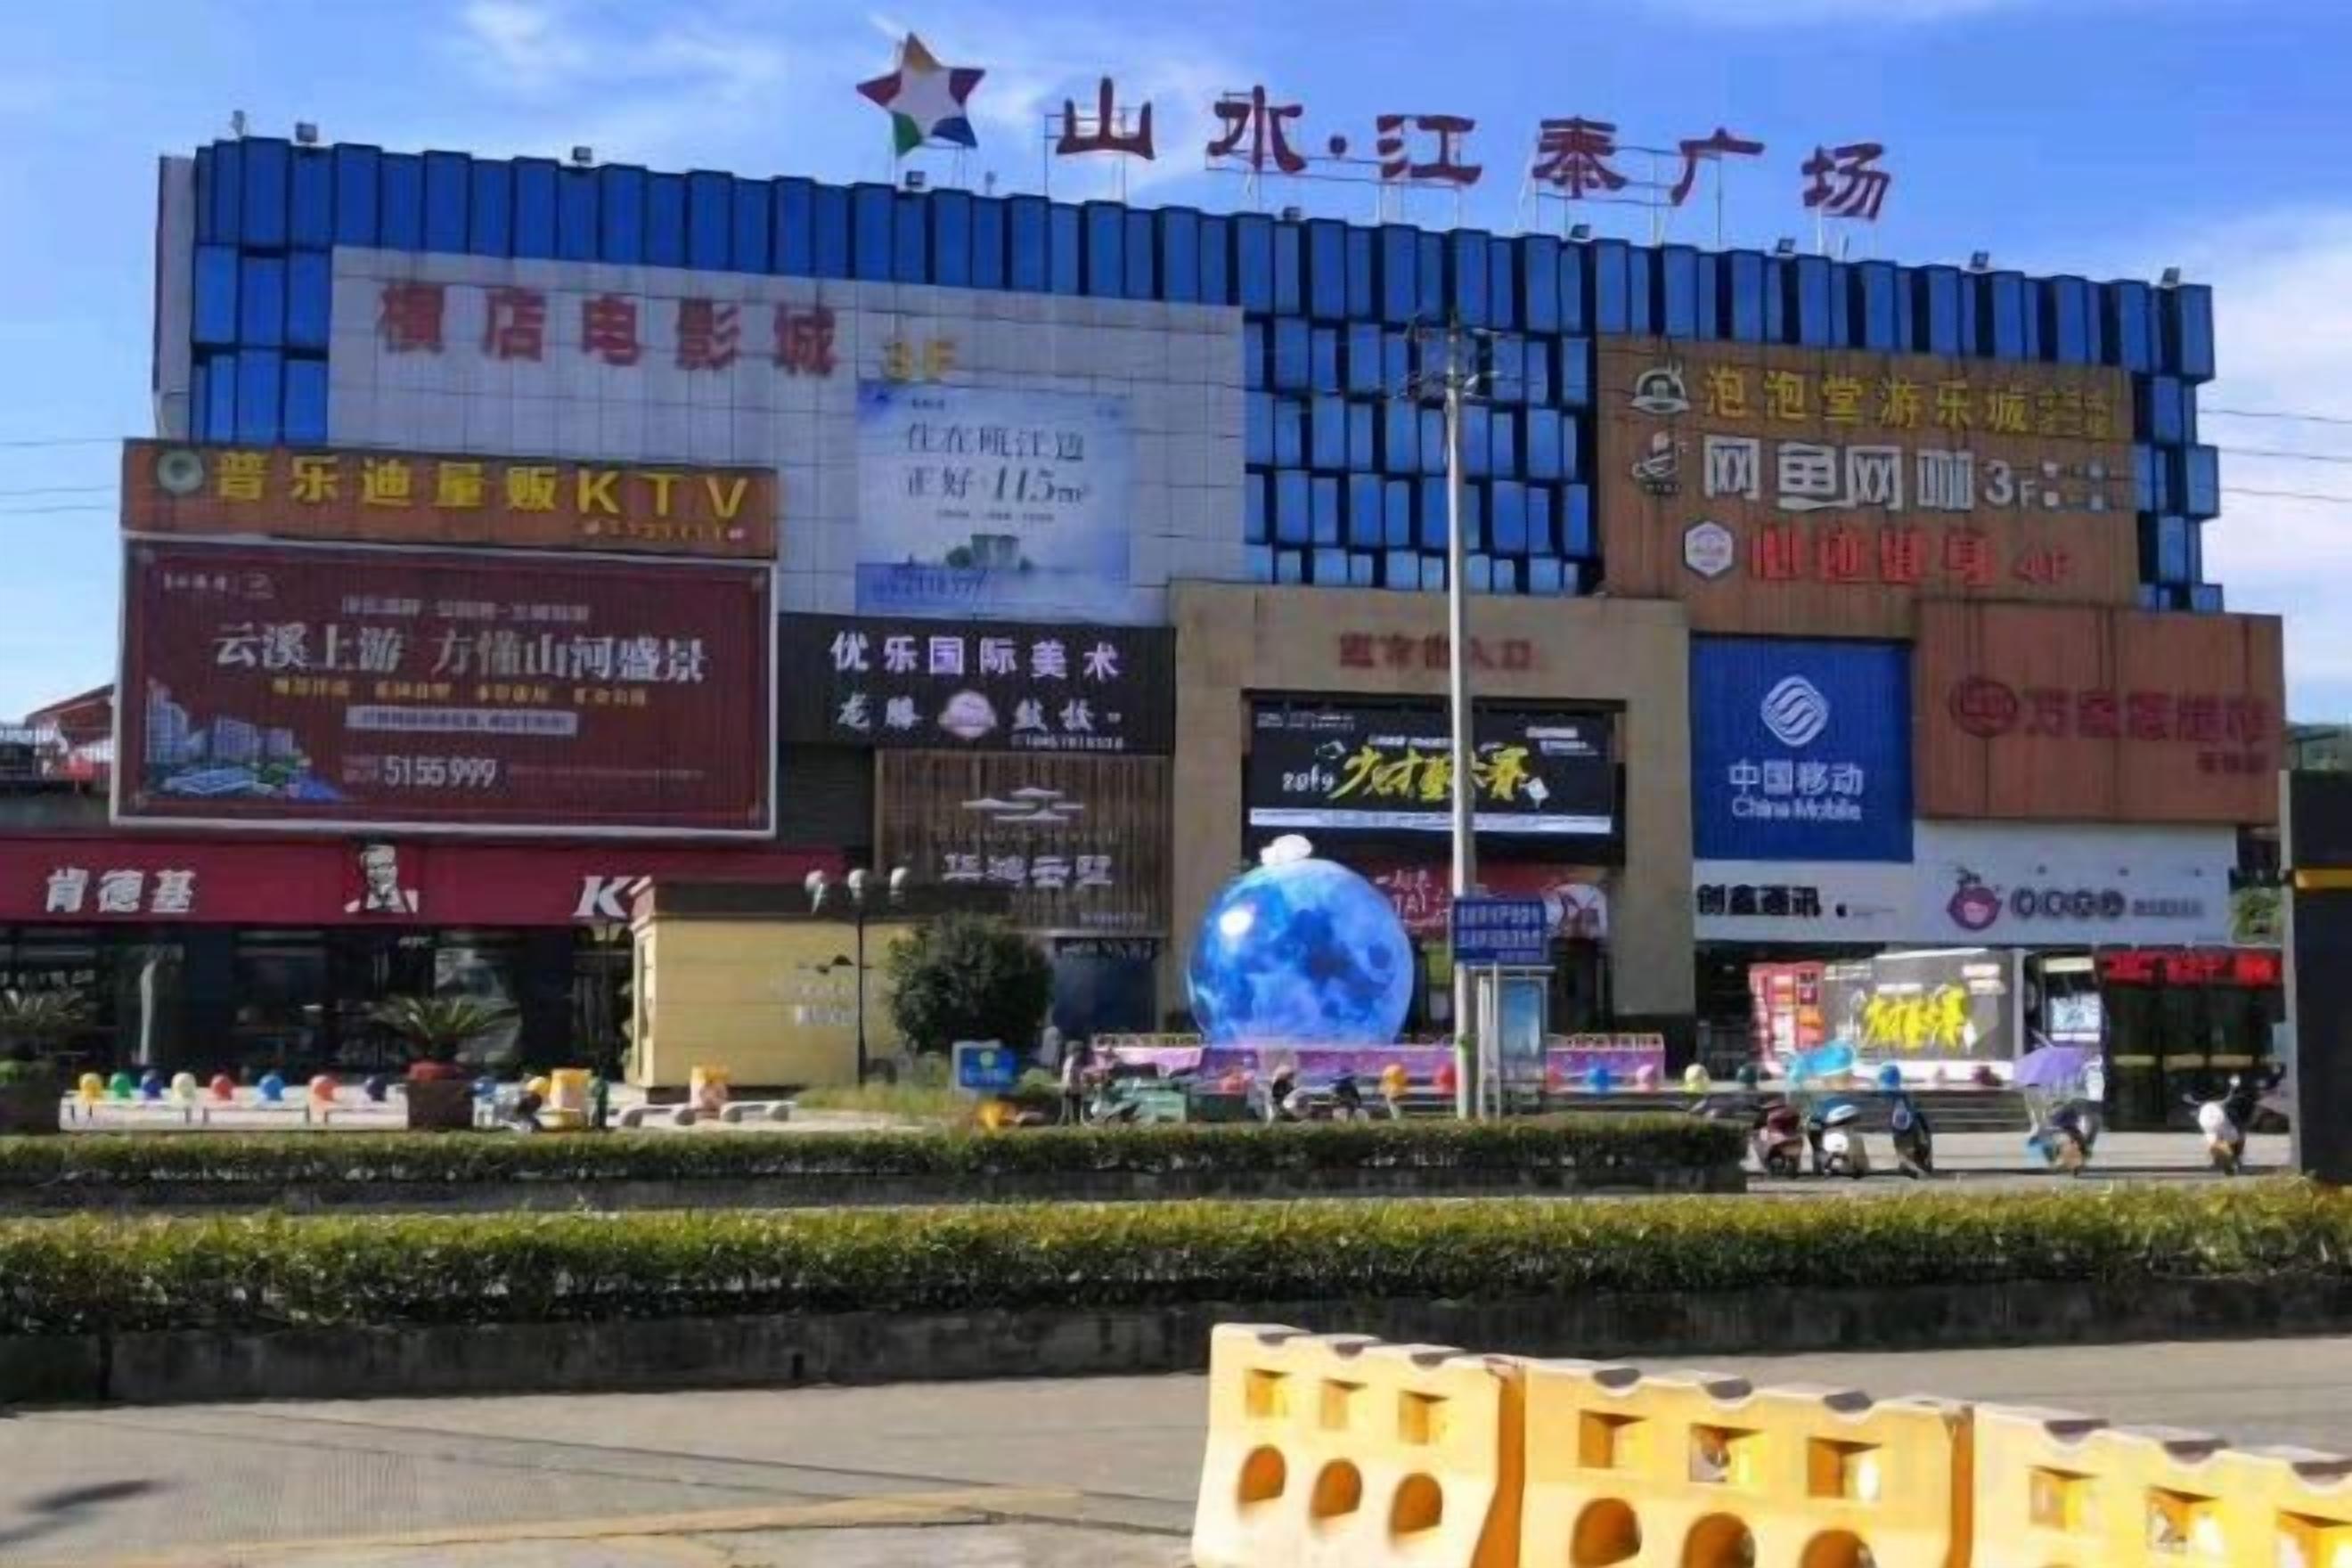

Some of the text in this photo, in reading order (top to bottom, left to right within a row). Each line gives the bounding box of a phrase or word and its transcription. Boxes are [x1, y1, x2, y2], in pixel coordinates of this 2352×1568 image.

[830, 631, 1119, 682] 优乐国际美术
[1729, 757, 1865, 796] 中国移动
[1731, 796, 1862, 821] China Mobile
[46, 868, 196, 914] 肯德基
